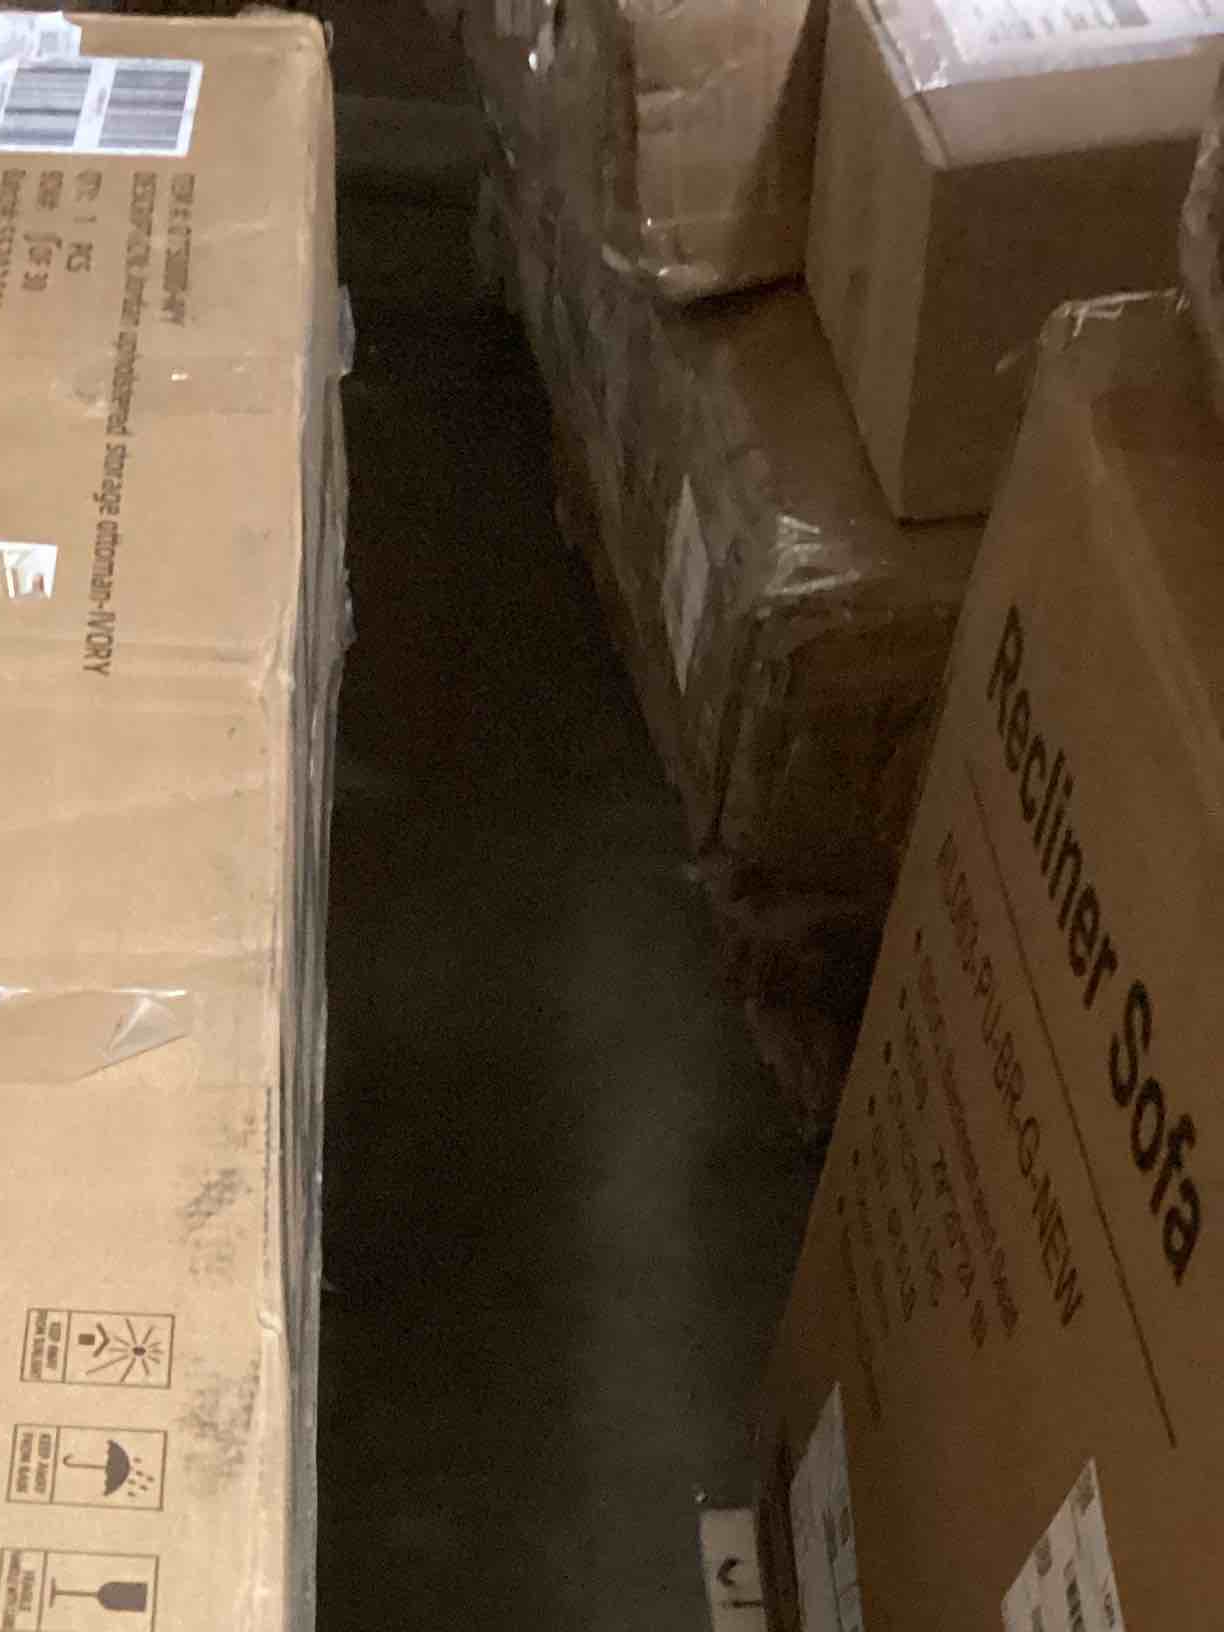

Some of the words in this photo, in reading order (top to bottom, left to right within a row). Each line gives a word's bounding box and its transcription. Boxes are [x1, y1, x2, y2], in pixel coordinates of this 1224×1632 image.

[92, 442, 132, 516] storage
[84, 520, 121, 677] ottoman-IVORY
[986, 604, 1118, 1010] Recliner
[1108, 979, 1201, 1287] Sofa
